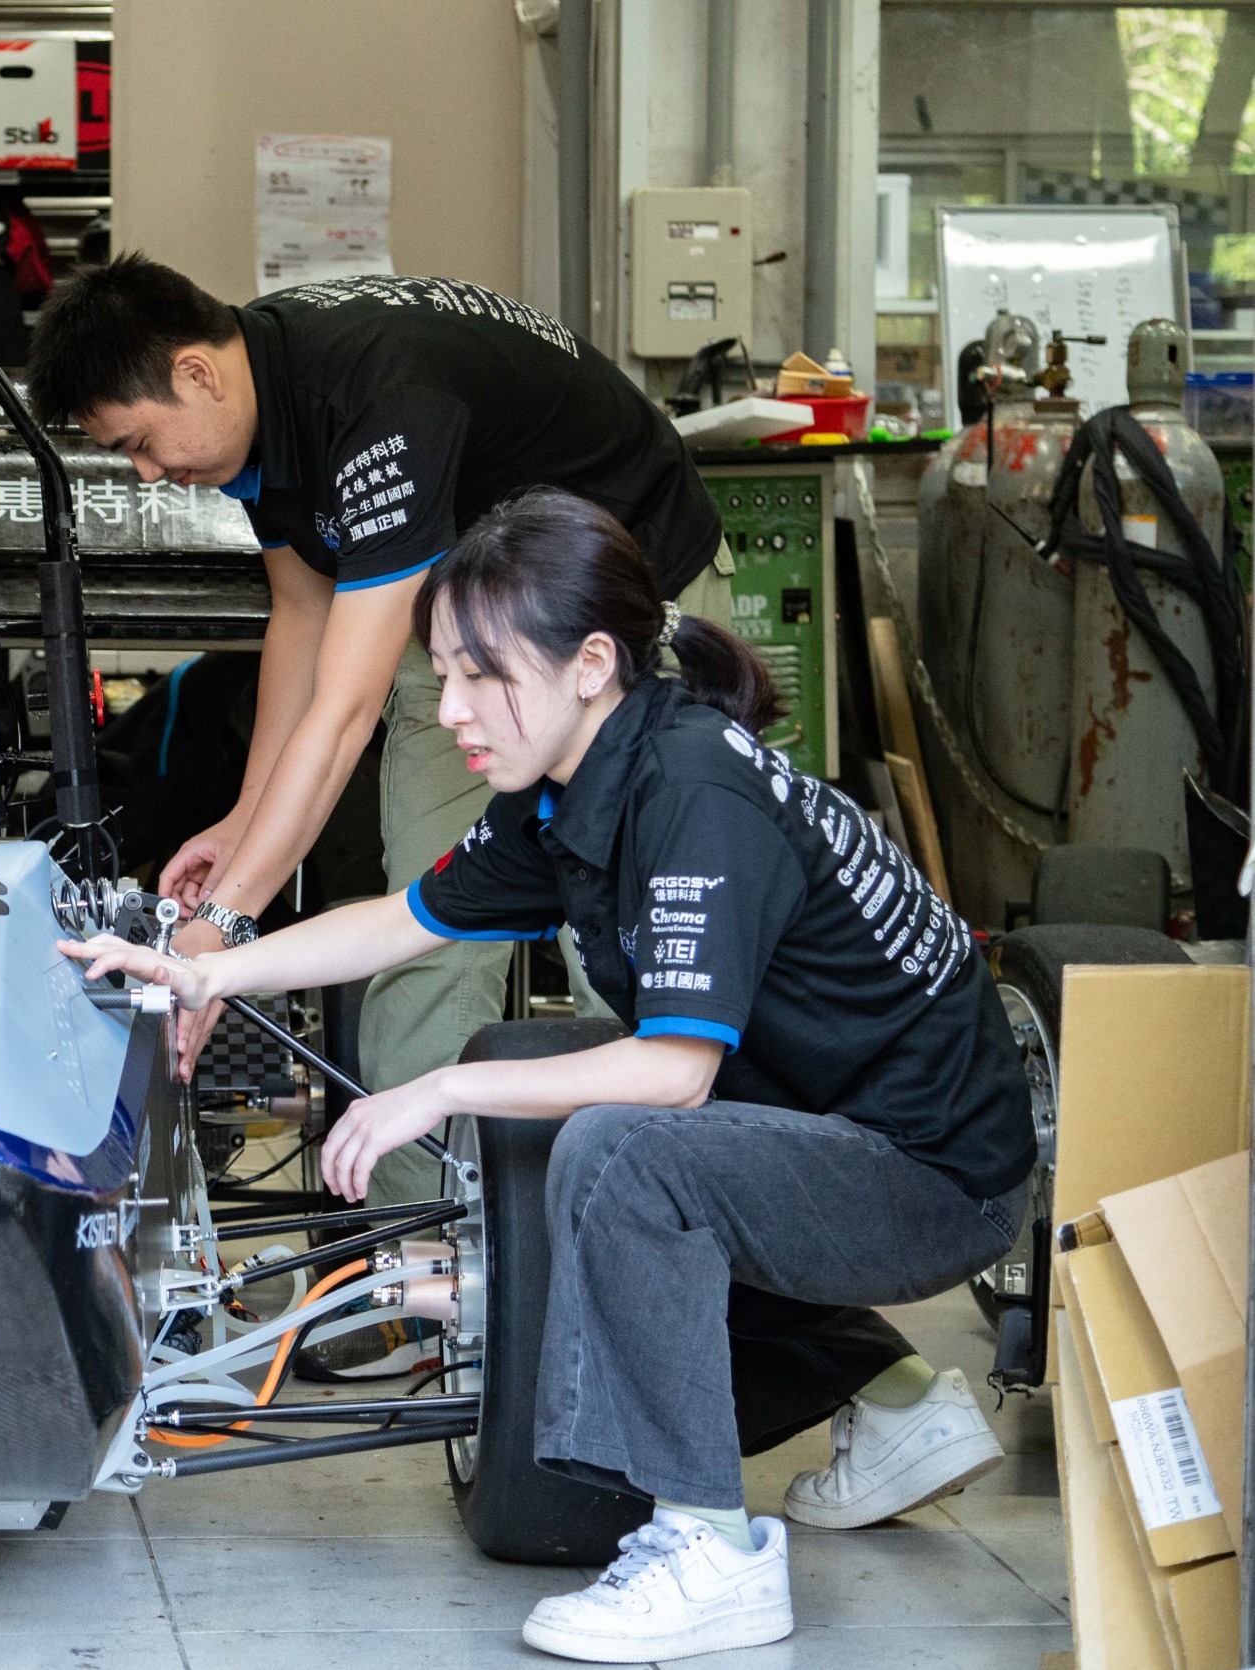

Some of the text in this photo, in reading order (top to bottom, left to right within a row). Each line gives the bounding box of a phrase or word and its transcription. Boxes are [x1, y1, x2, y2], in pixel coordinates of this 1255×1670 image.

[649, 876, 719, 890] ARGOSY
[654, 889, 702, 902] 優群科技
[649, 907, 706, 925] Chroma
